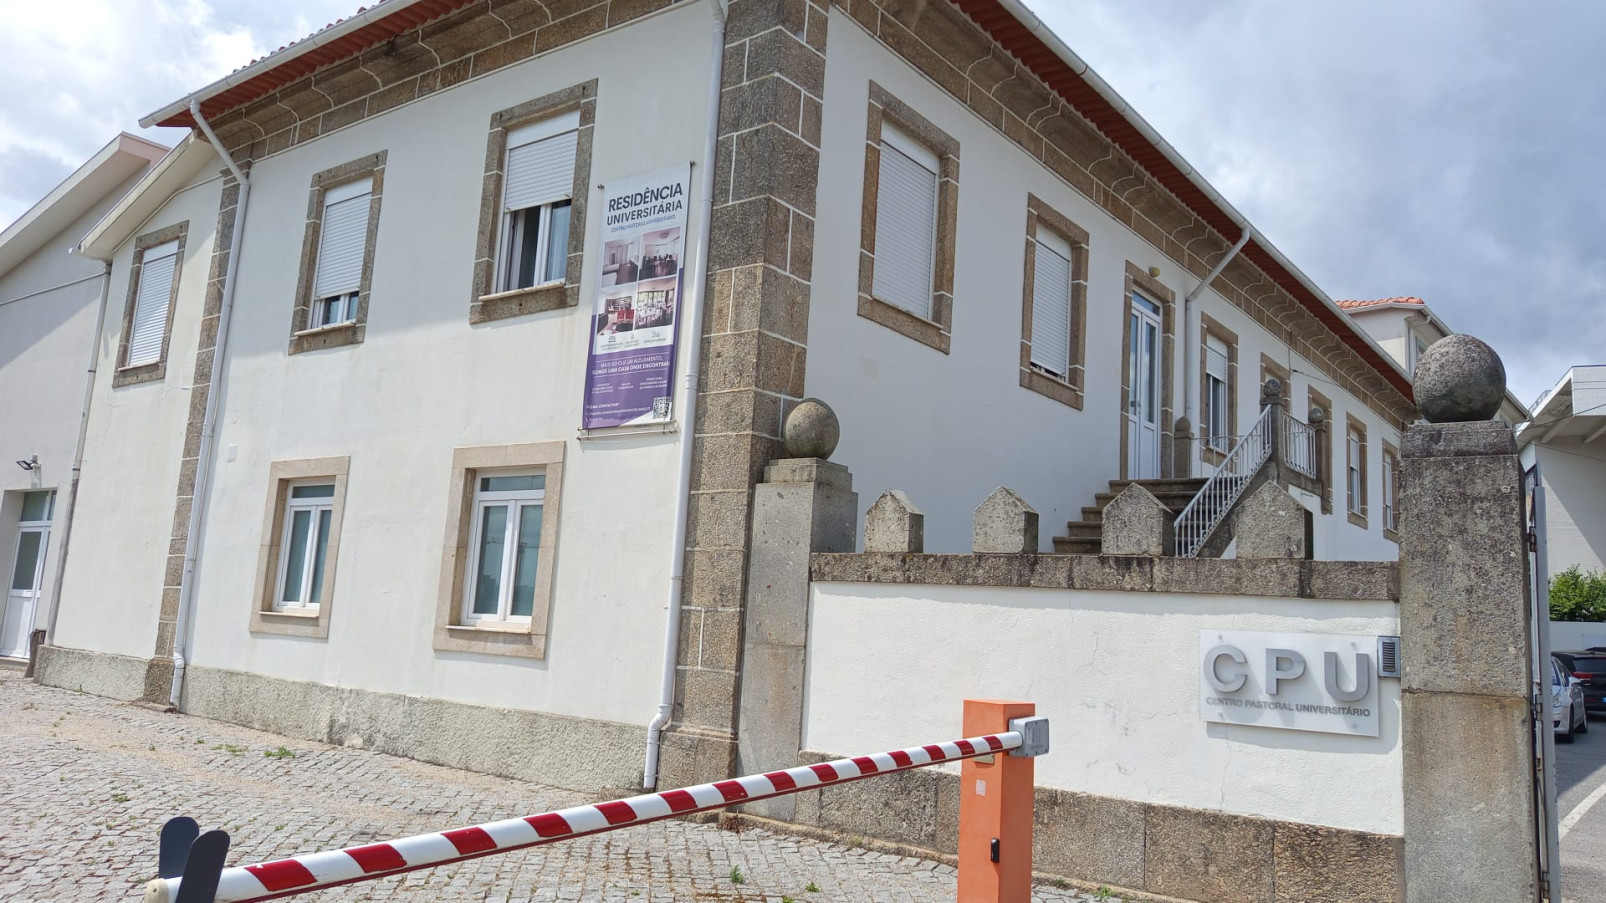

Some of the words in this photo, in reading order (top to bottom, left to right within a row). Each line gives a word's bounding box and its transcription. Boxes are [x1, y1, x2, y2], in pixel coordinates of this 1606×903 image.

[609, 183, 682, 212] RESIDÊNCIA
[607, 200, 682, 226] UNIVERSITÁRIA
[1203, 645, 1370, 702] CPU
[1206, 697, 1243, 707] CENTRO
[1244, 699, 1293, 711] PASTORAL
[1296, 704, 1370, 717] UNIVERSITÁRIO
